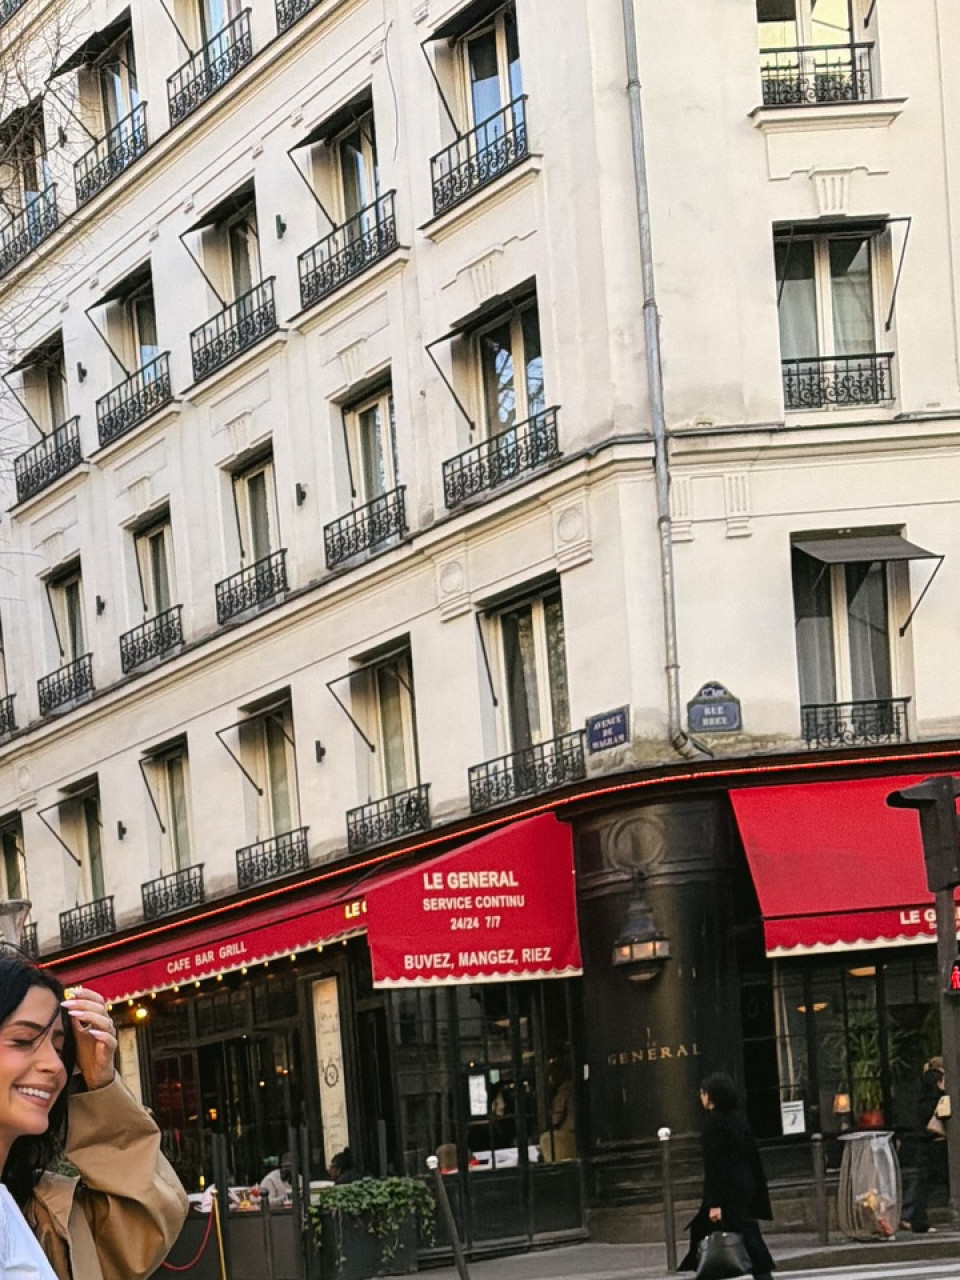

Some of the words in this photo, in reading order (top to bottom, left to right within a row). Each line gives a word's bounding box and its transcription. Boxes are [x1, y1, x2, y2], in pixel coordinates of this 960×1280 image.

[423, 872, 444, 890] LE
[447, 870, 519, 889] GENERAL
[344, 901, 360, 919] LE
[423, 896, 472, 911] SERVICE
[475, 895, 525, 909] CONTINU
[450, 916, 480, 930] 24/24
[485, 915, 501, 928] 7/7
[900, 910, 921, 925] LE
[167, 957, 191, 974] CAFE
[195, 950, 214, 966] BAR
[219, 941, 247, 959] GRILL
[404, 952, 454, 970] BUVEZ,
[458, 949, 518, 967] MANGEZ,
[522, 947, 552, 962] RIEZ
